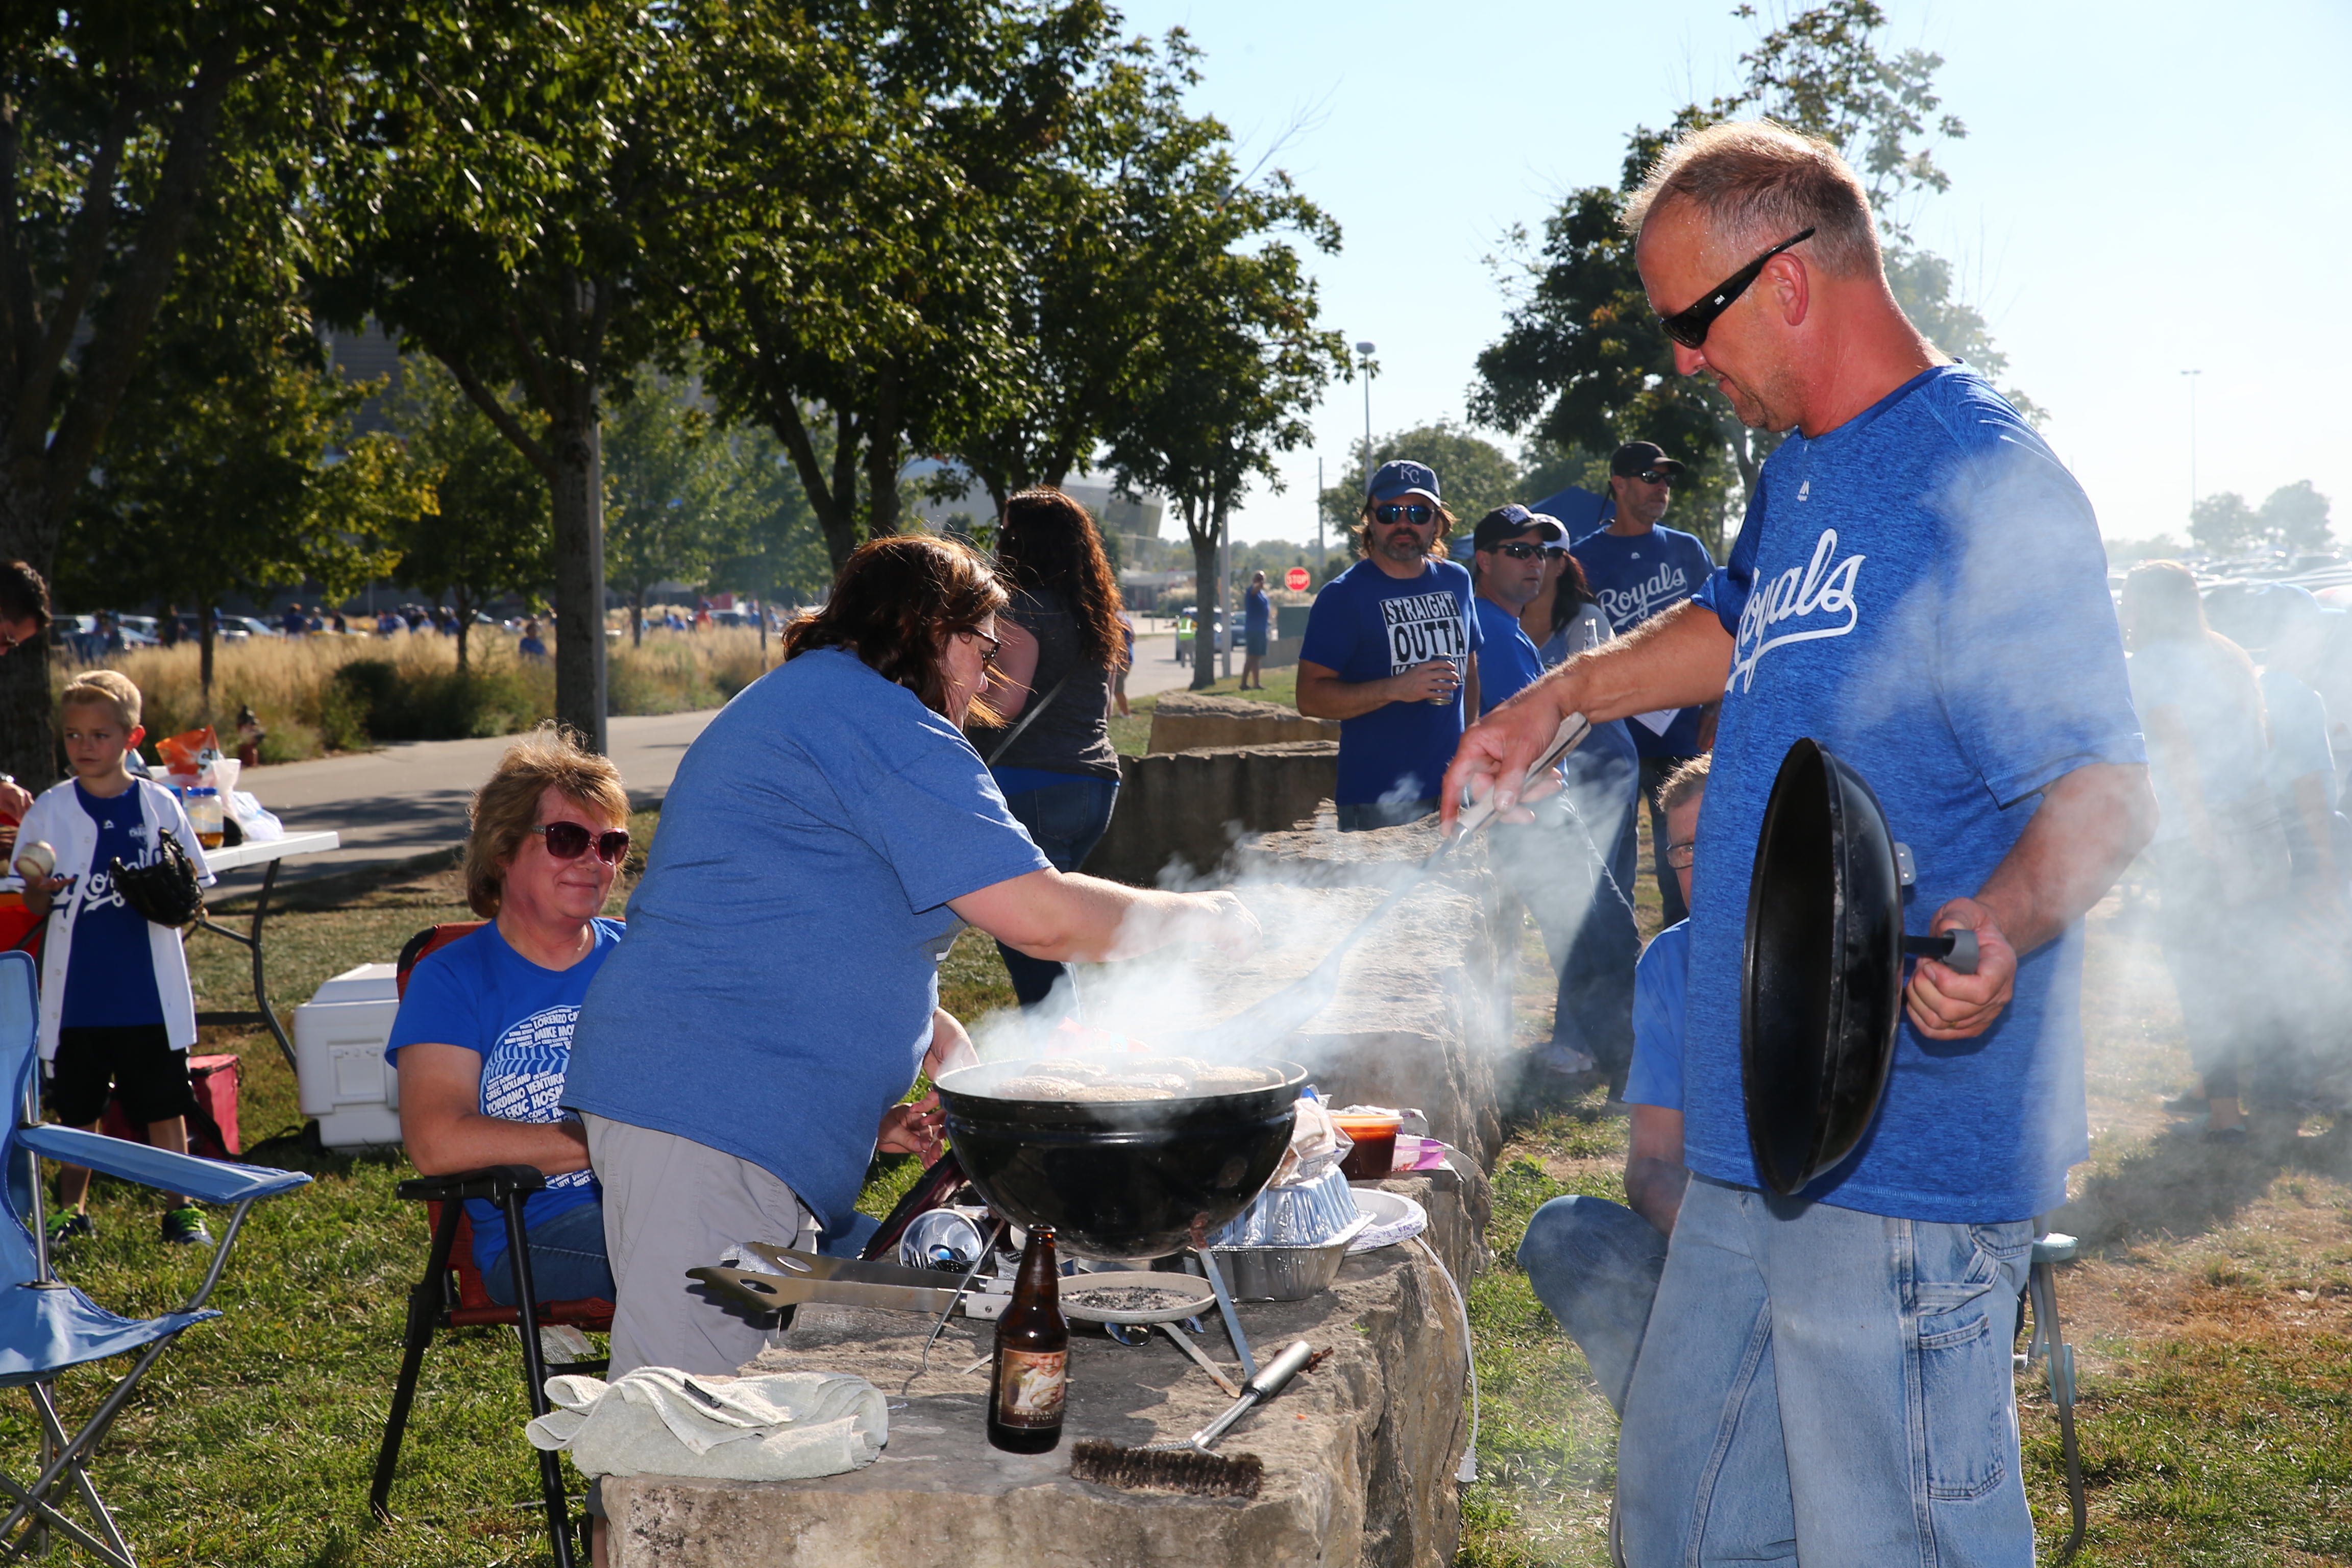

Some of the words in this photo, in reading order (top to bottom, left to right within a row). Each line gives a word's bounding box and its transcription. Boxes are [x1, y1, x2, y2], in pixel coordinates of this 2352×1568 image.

[1401, 465, 1419, 484] KC
[1287, 574, 1308, 585] STOP
[1596, 562, 1687, 627] Royals
[1385, 593, 1456, 624] STRAIGHT
[1394, 617, 1465, 663] OUTTA
[533, 1013, 567, 1030] LORENZO
[534, 1026, 557, 1042] MIKE
[485, 1087, 502, 1101] GREG
[502, 1073, 531, 1093] HOLLAND
[486, 1080, 500, 1092] SCOTT
[486, 1087, 526, 1114] YORDANO
[526, 1072, 565, 1095] VENTURA
[504, 1098, 530, 1118] ERIC
[573, 1174, 591, 1187] BRUCE
